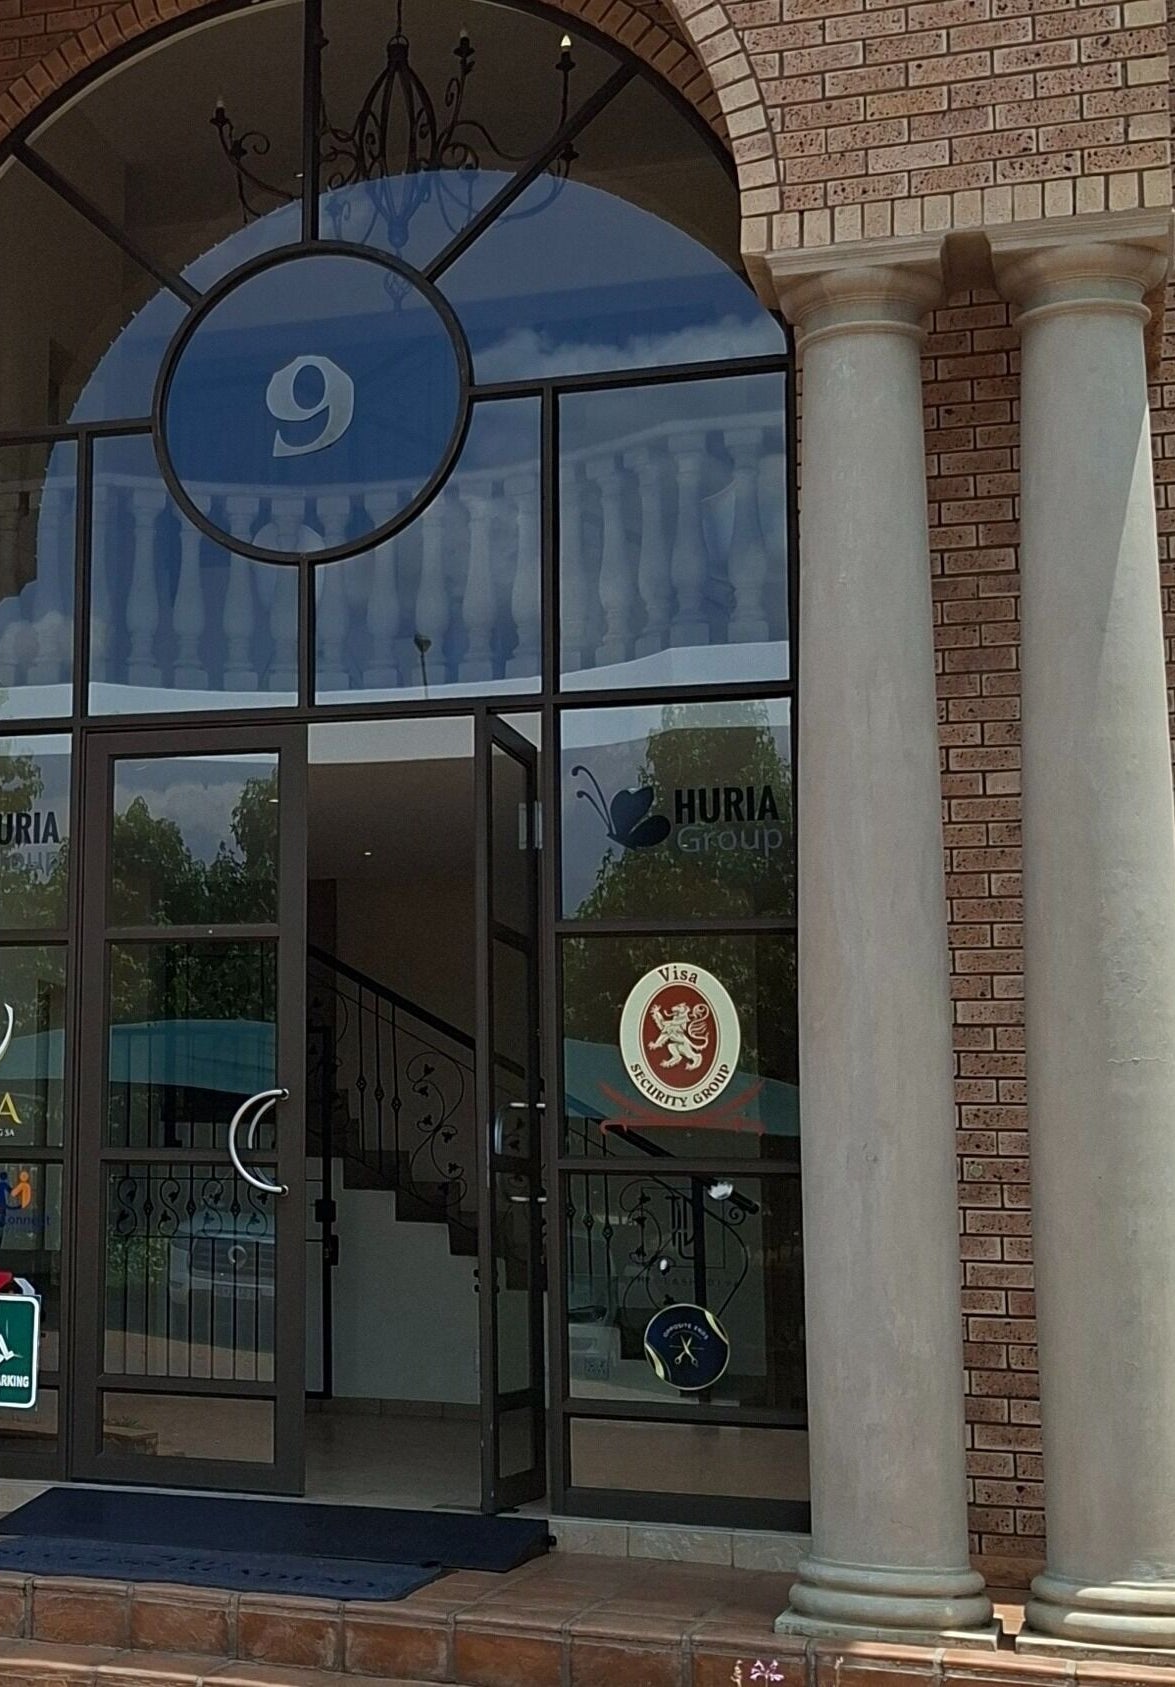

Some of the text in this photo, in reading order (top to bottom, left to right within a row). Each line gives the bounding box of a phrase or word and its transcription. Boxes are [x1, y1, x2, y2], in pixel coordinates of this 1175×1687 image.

[266, 355, 355, 458] 9
[674, 785, 779, 825] HURIA
[677, 825, 783, 858] Group
[657, 965, 698, 985] Visa
[630, 1063, 731, 1108] SECURITY GROUP
[5, 1128, 15, 1136] SA
